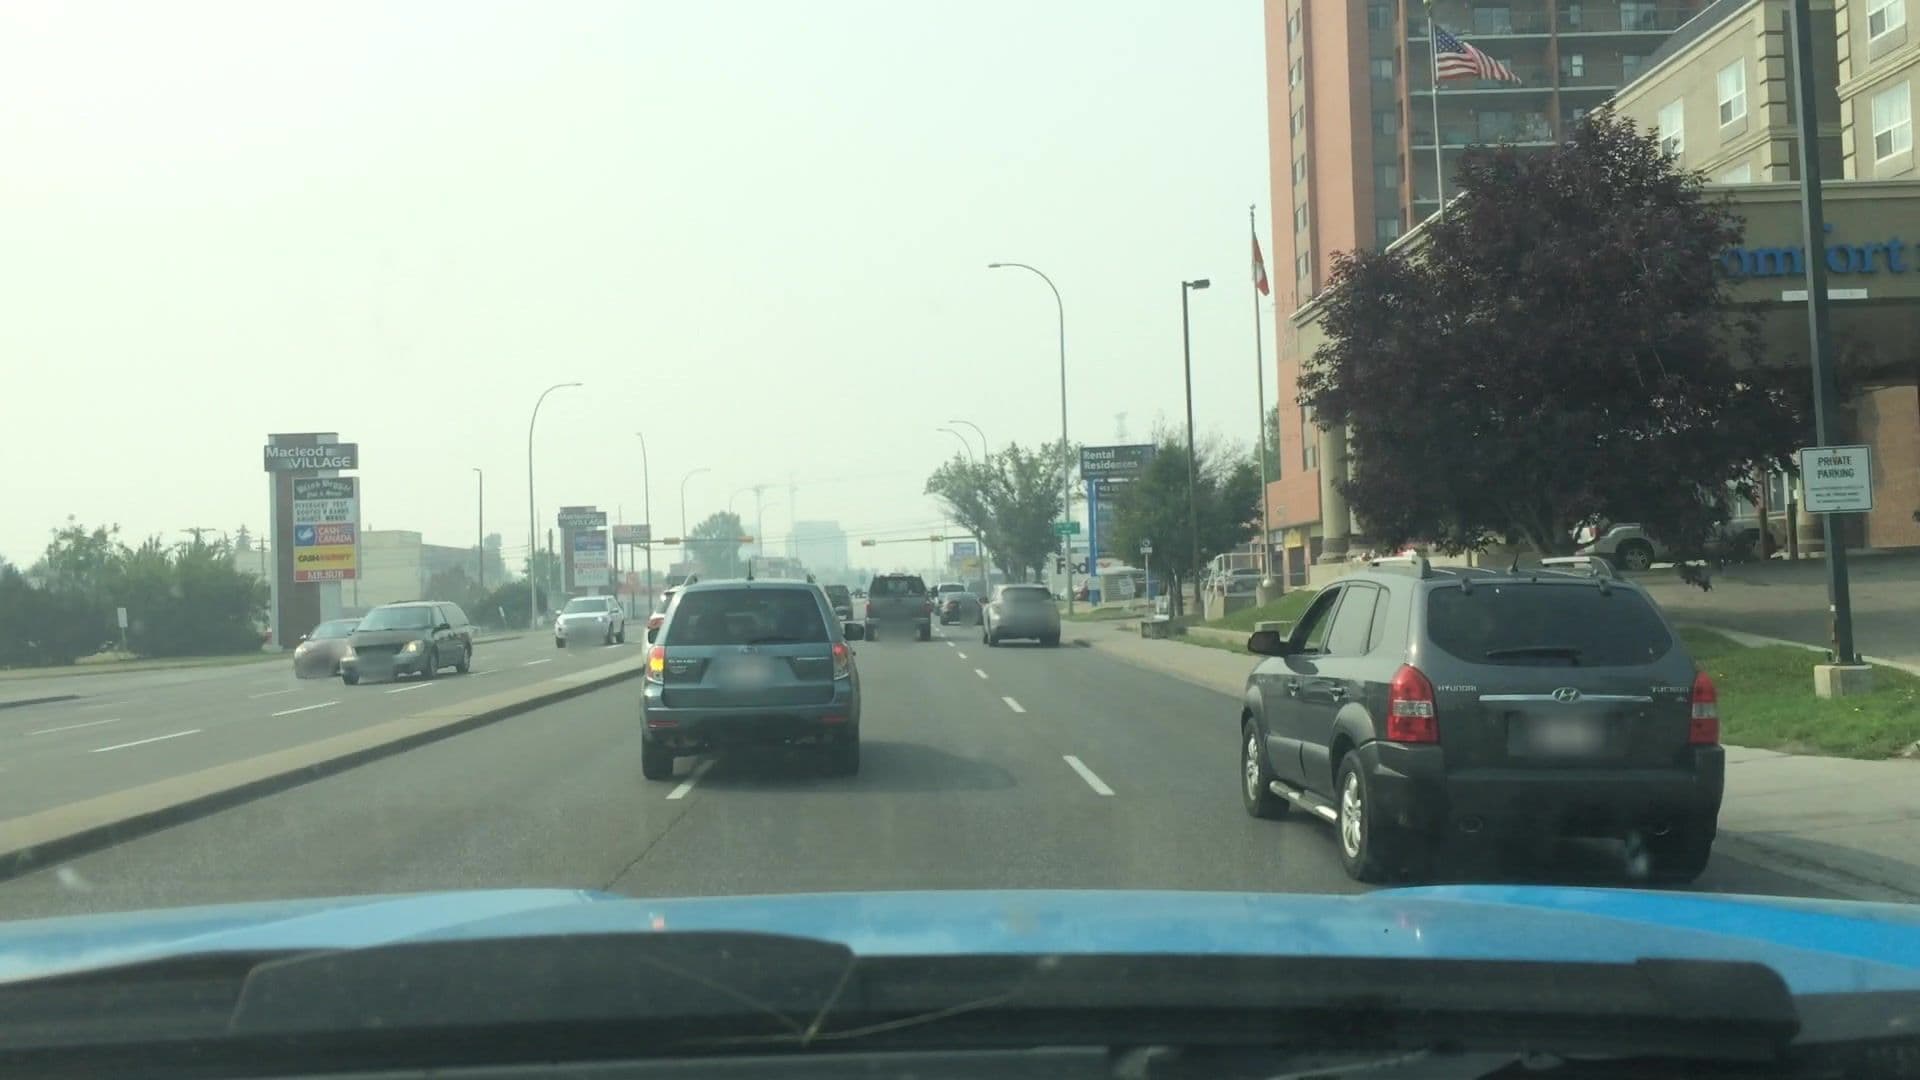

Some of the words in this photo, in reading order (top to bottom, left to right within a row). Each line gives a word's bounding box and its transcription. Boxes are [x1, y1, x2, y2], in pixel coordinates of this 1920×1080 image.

[1721, 222, 1905, 275] omort
[266, 446, 325, 458] Macleod
[1083, 449, 1115, 460] Rental
[289, 457, 351, 468] VILLAGE
[1083, 461, 1138, 471] Residences
[1818, 456, 1851, 466] PRIVATE
[1817, 468, 1855, 479] PARKING
[1437, 684, 1477, 692] HYUNDAI
